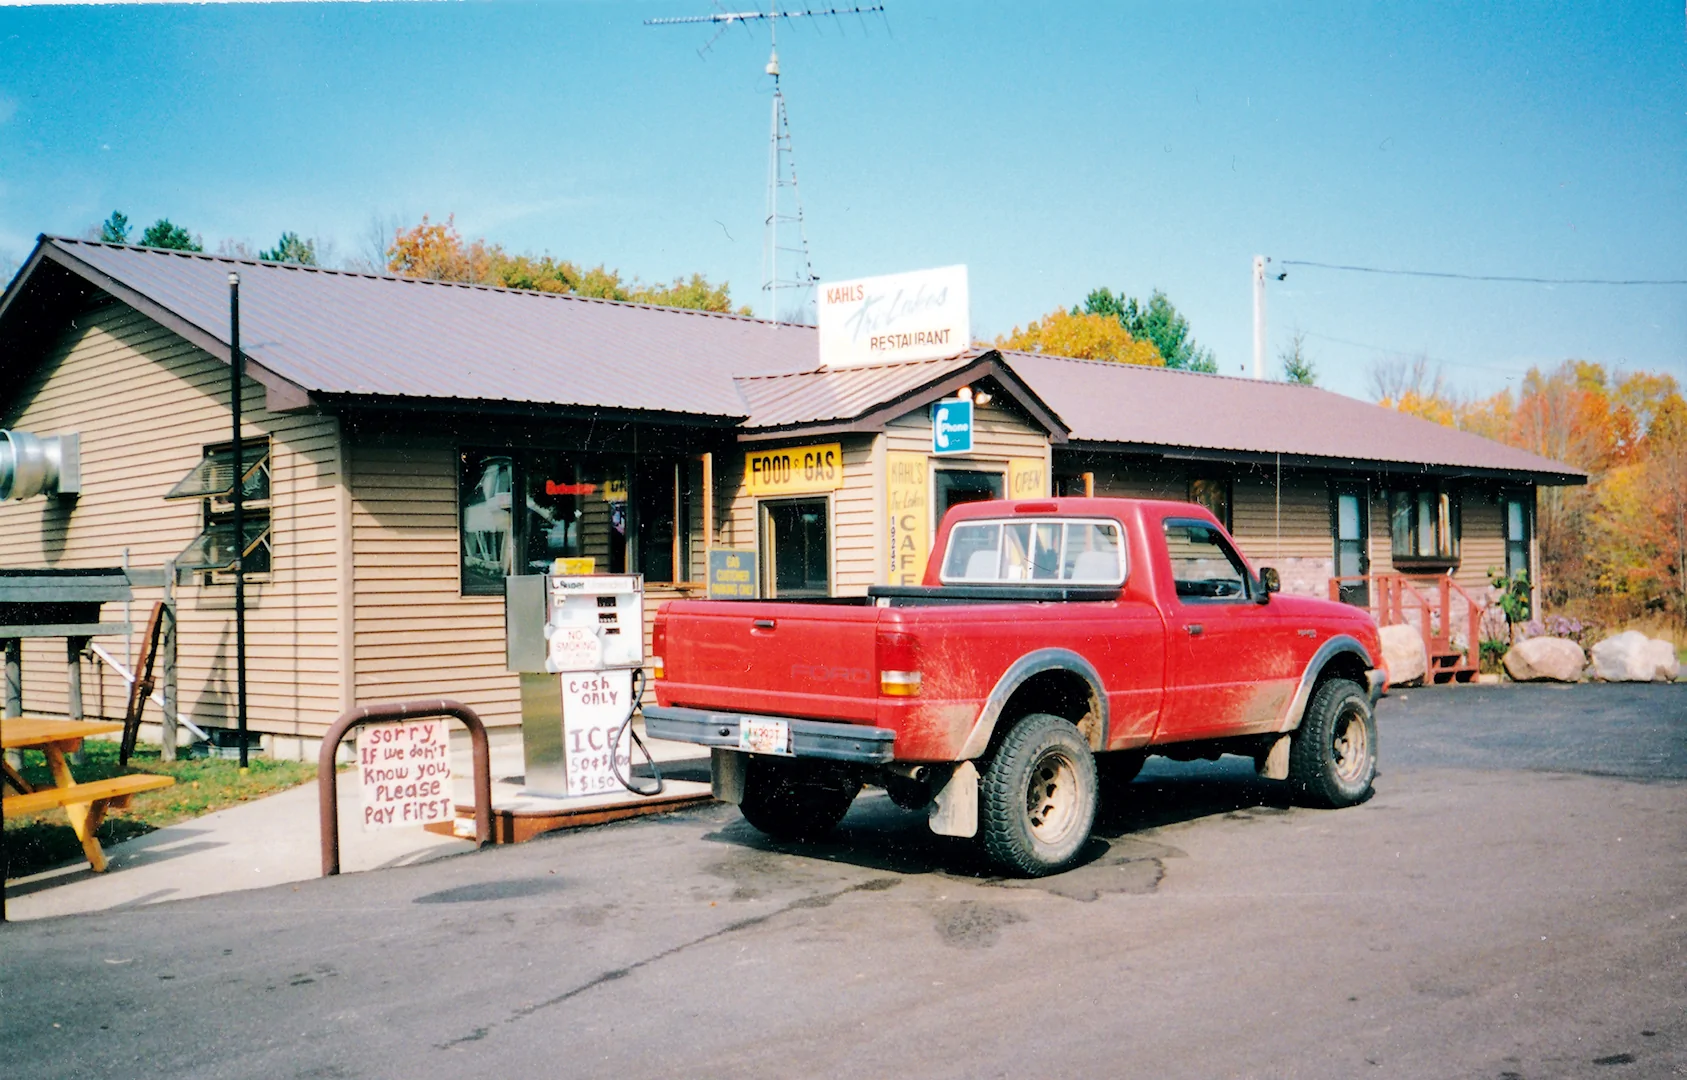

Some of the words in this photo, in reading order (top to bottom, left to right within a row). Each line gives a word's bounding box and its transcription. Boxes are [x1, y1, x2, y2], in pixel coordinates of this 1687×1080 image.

[827, 284, 864, 304] KAHLS
[870, 328, 951, 350] RESTAURANT
[942, 422, 969, 433] Phone
[752, 455, 790, 486] FOOD
[794, 458, 801, 477] &
[804, 451, 835, 481] GAS
[1015, 469, 1043, 494] OPEN
[900, 515, 916, 586] CAFE
[568, 630, 583, 640] NO
[556, 641, 597, 653] SMOKING
[791, 664, 872, 684] FORD
[569, 726, 621, 753] ICE
[415, 762, 451, 780] you,
